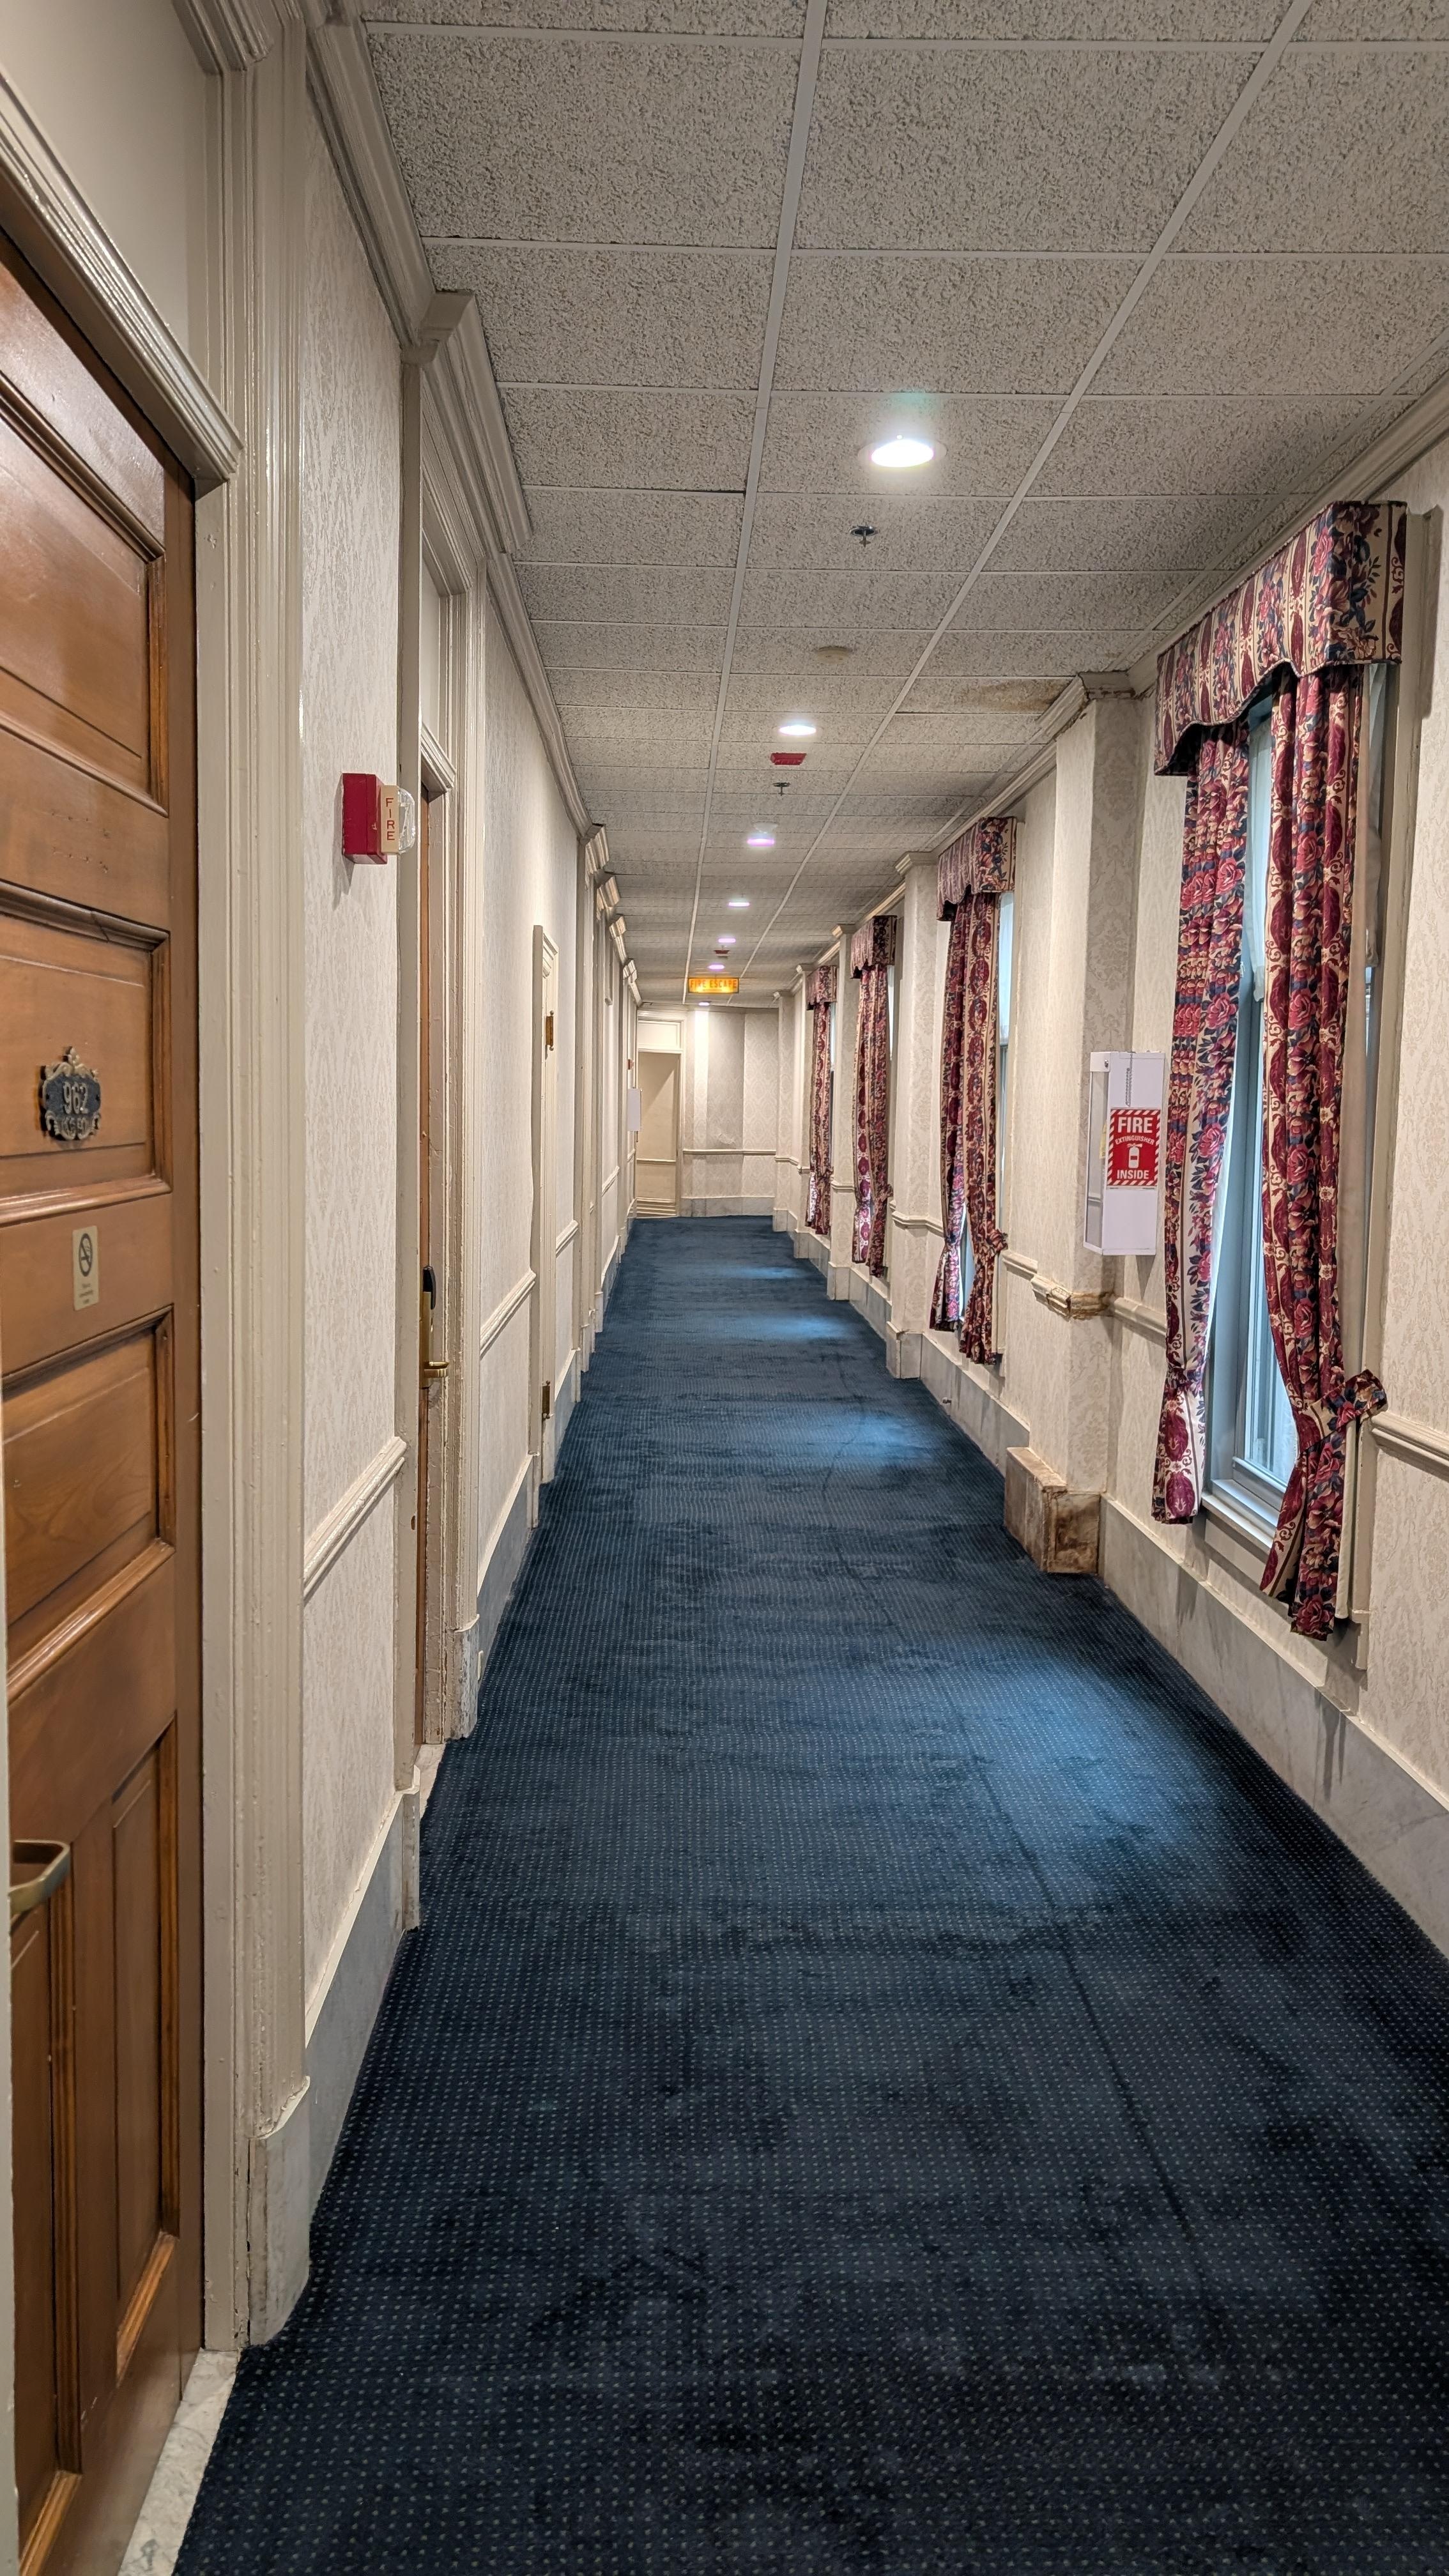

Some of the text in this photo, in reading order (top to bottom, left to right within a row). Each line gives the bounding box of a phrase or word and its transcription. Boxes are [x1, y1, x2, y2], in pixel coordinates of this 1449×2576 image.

[385, 797, 395, 841] FIRE
[690, 979, 737, 988] FIRE ESCAPE
[63, 1081, 89, 1115] 962
[1117, 1117, 1154, 1133] FIRE
[1114, 1135, 1155, 1146] EXTINGUISHER
[1117, 1169, 1149, 1179] INSIDE
